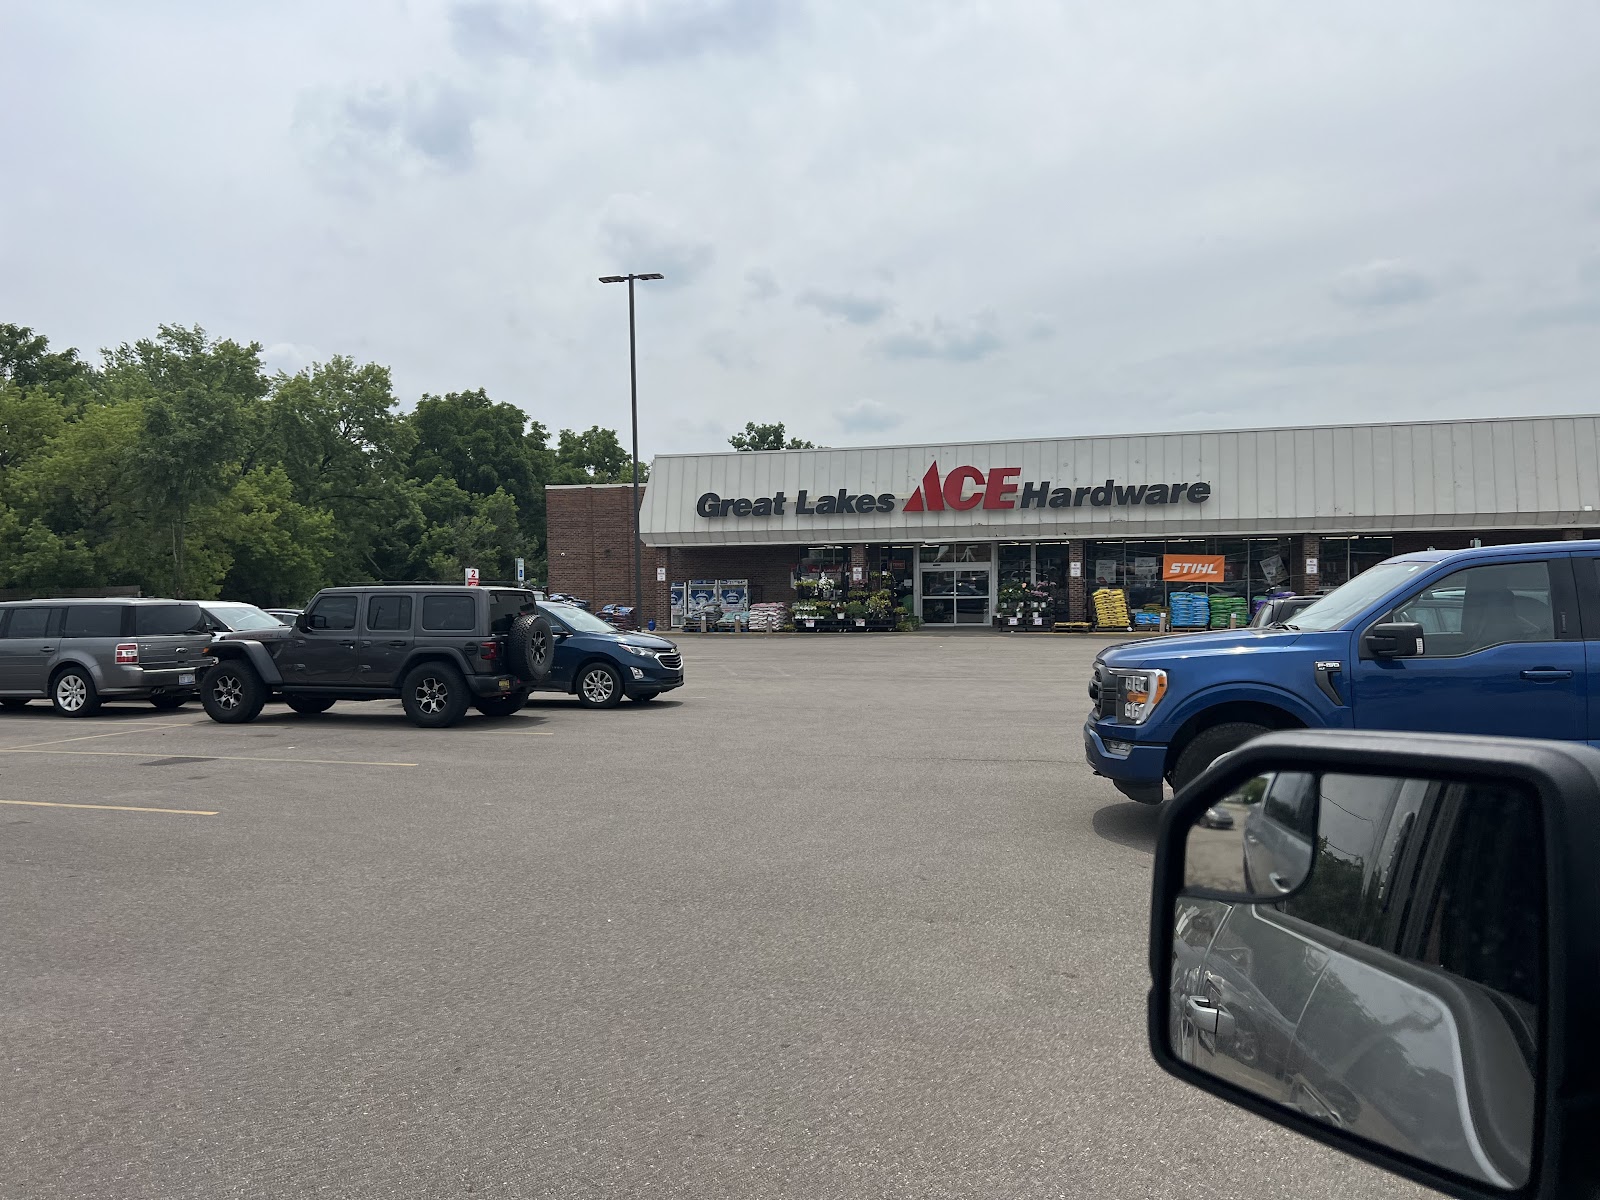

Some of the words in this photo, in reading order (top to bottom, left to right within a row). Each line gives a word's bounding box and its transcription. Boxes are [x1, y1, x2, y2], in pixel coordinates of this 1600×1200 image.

[697, 492, 786, 517] Great
[796, 489, 895, 514] Lakes
[902, 460, 1021, 511] ACE
[1020, 480, 1211, 509] Hardware
[1169, 562, 1218, 574] STIHL
